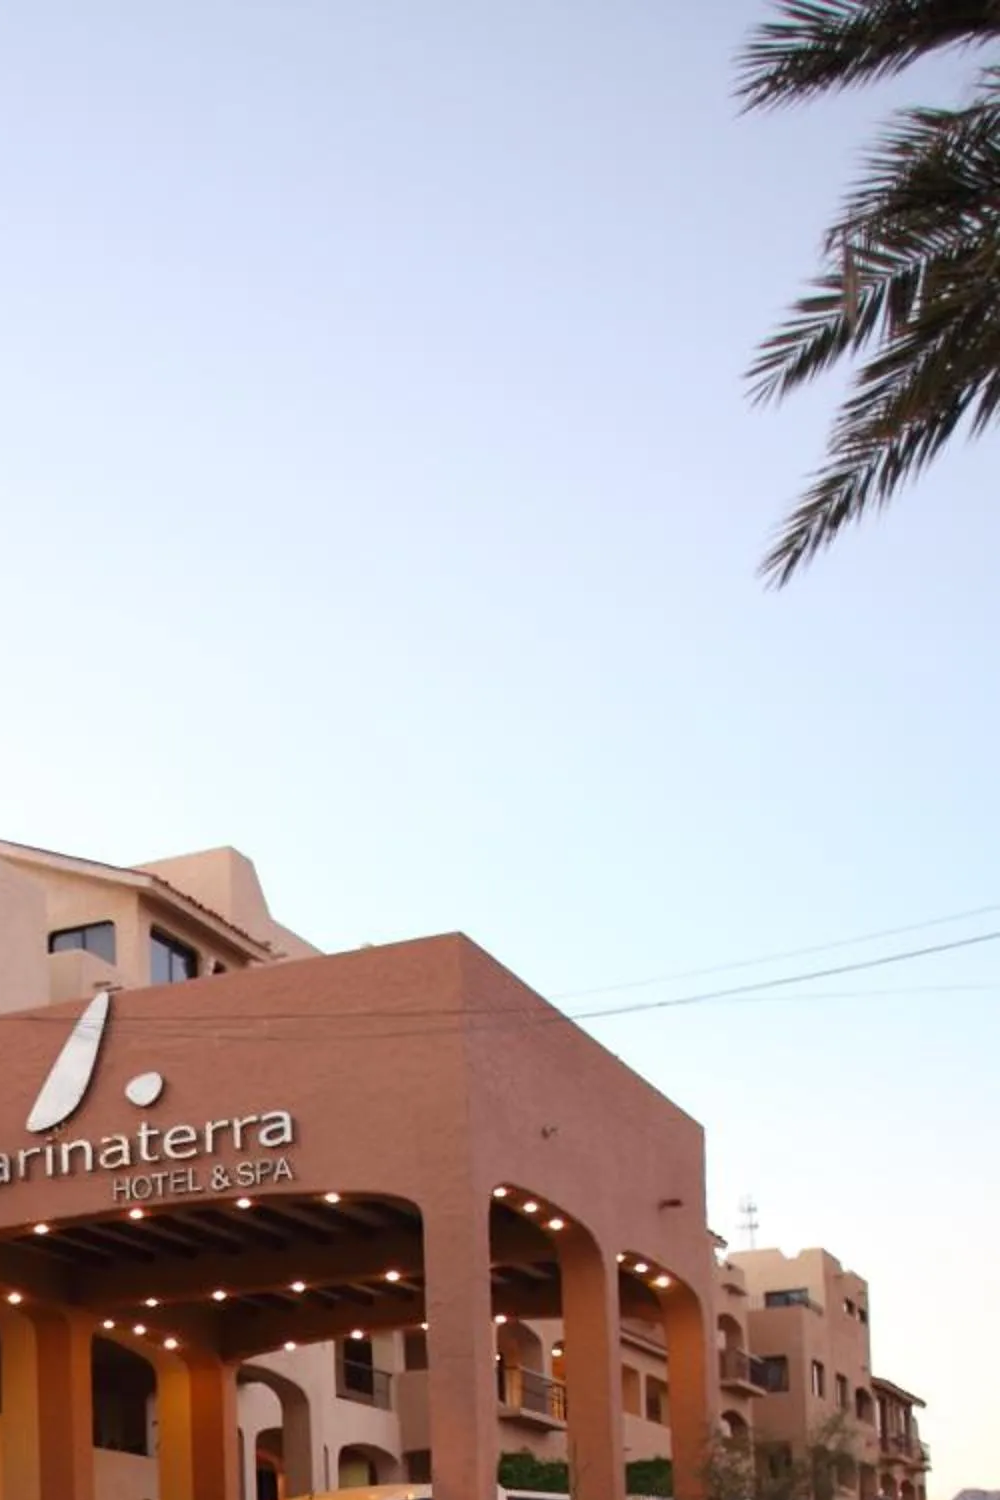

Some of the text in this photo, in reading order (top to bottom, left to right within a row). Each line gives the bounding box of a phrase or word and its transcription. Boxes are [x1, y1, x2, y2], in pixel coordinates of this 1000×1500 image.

[113, 1158, 294, 1200] HOTEL & SPA
